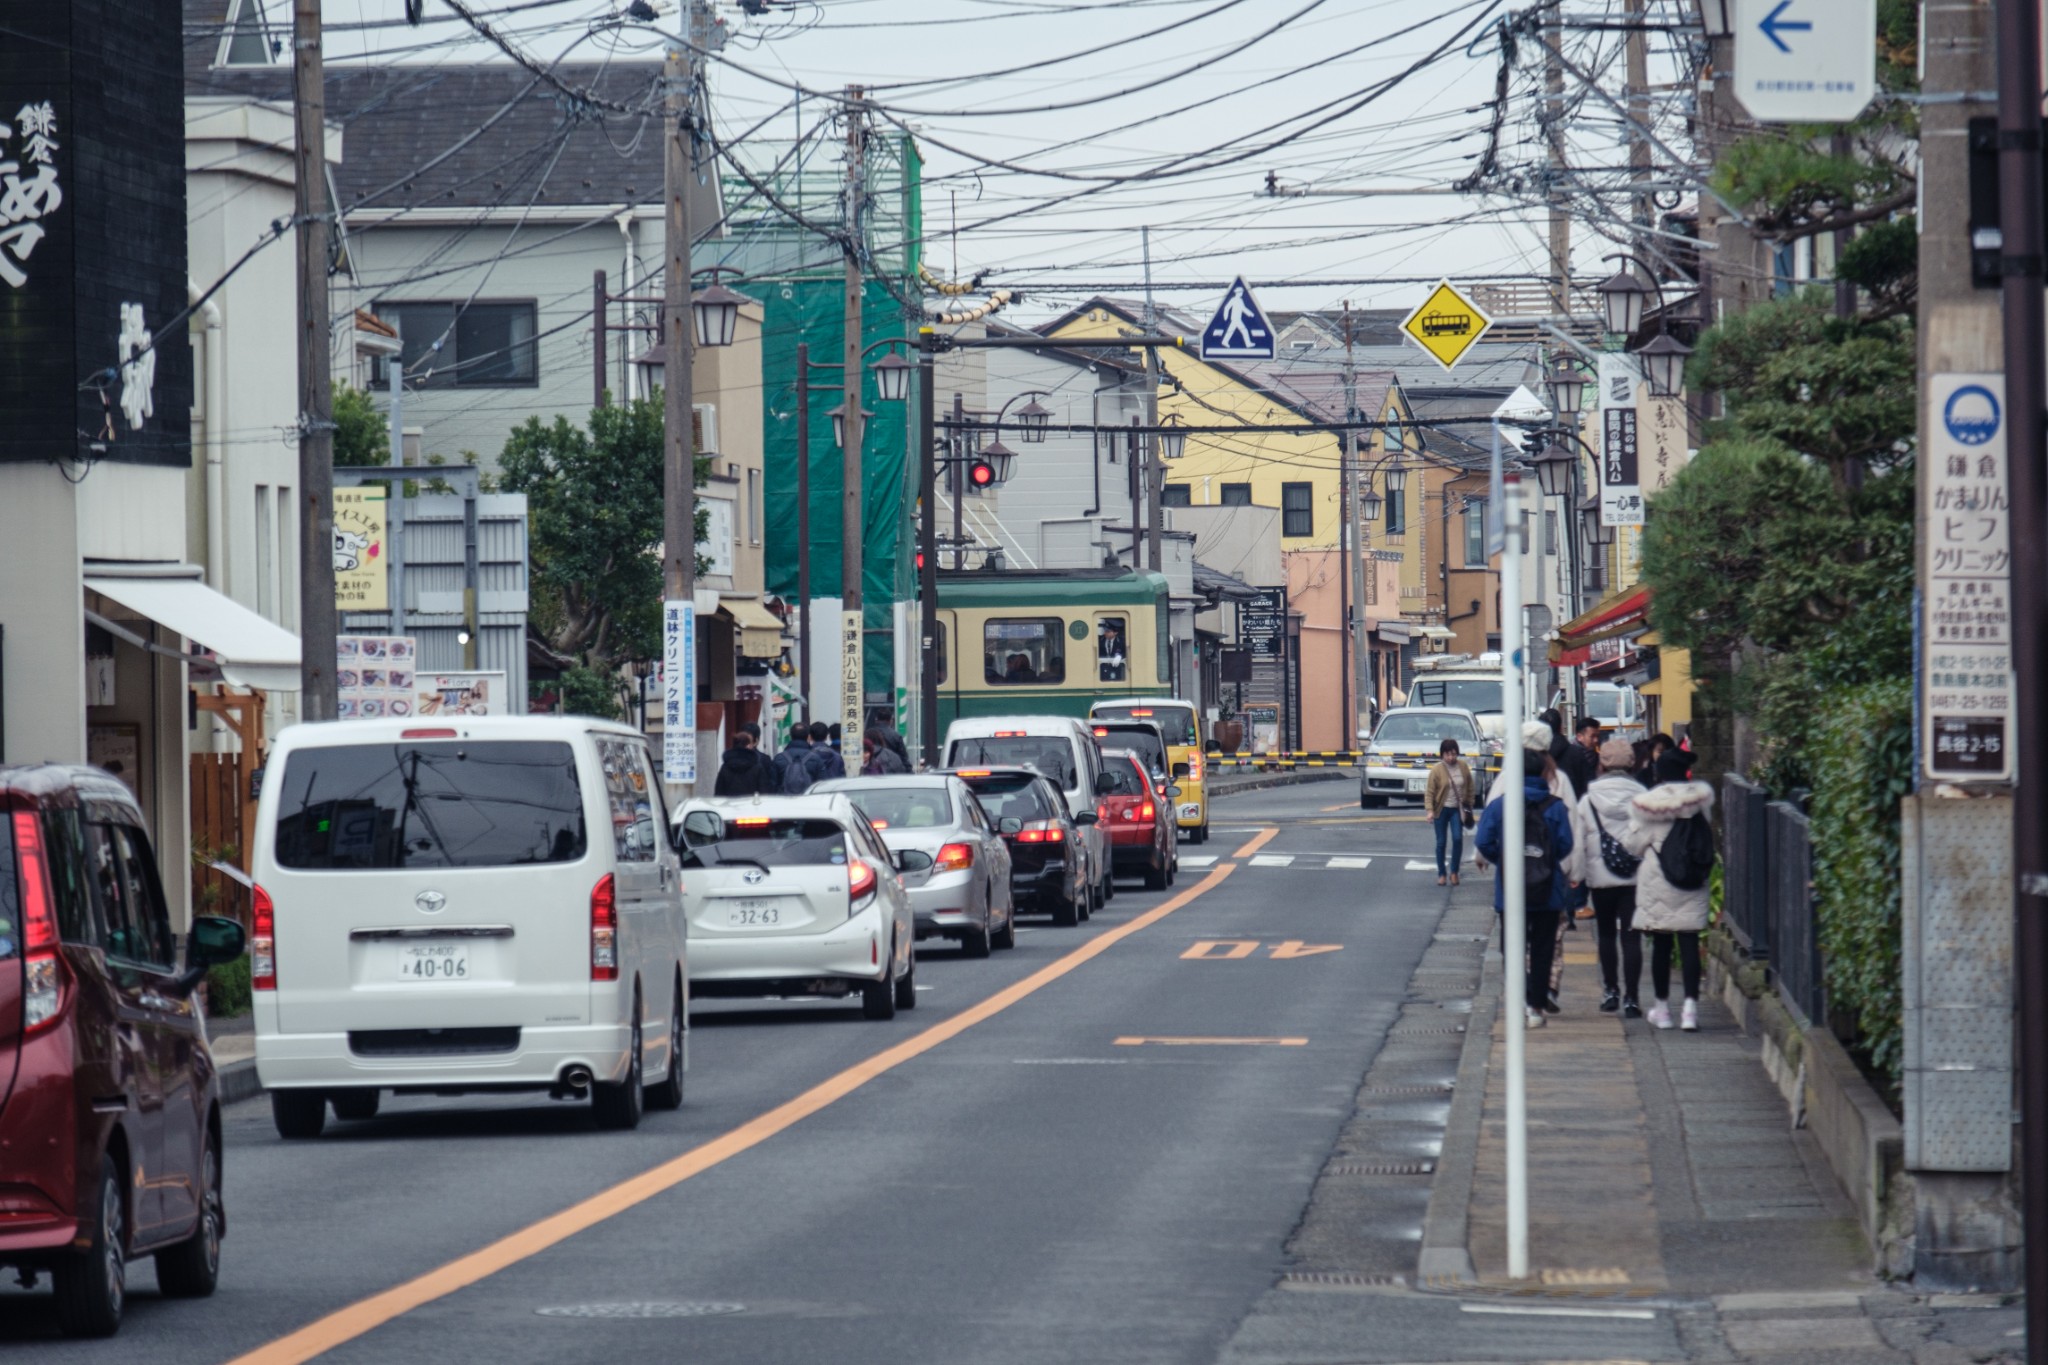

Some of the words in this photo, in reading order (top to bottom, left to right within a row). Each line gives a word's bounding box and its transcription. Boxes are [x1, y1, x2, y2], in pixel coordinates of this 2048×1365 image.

[16, 100, 59, 164] 鎌倉
[1624, 412, 1635, 455] 伝統の味
[1608, 410, 1622, 482] 富岡の鎌倉ハム
[1947, 455, 1996, 479] 鎌倉
[1605, 495, 1640, 511] 一心亭
[1605, 513, 1616, 522] TEL
[1945, 517, 1997, 543] ヒフ
[1934, 548, 2009, 572] クリニック
[1949, 582, 1992, 595] 皮膚科
[1938, 735, 2000, 753] 長谷2-15
[740, 909, 778, 924] 32-63
[413, 958, 466, 978] 40-06
